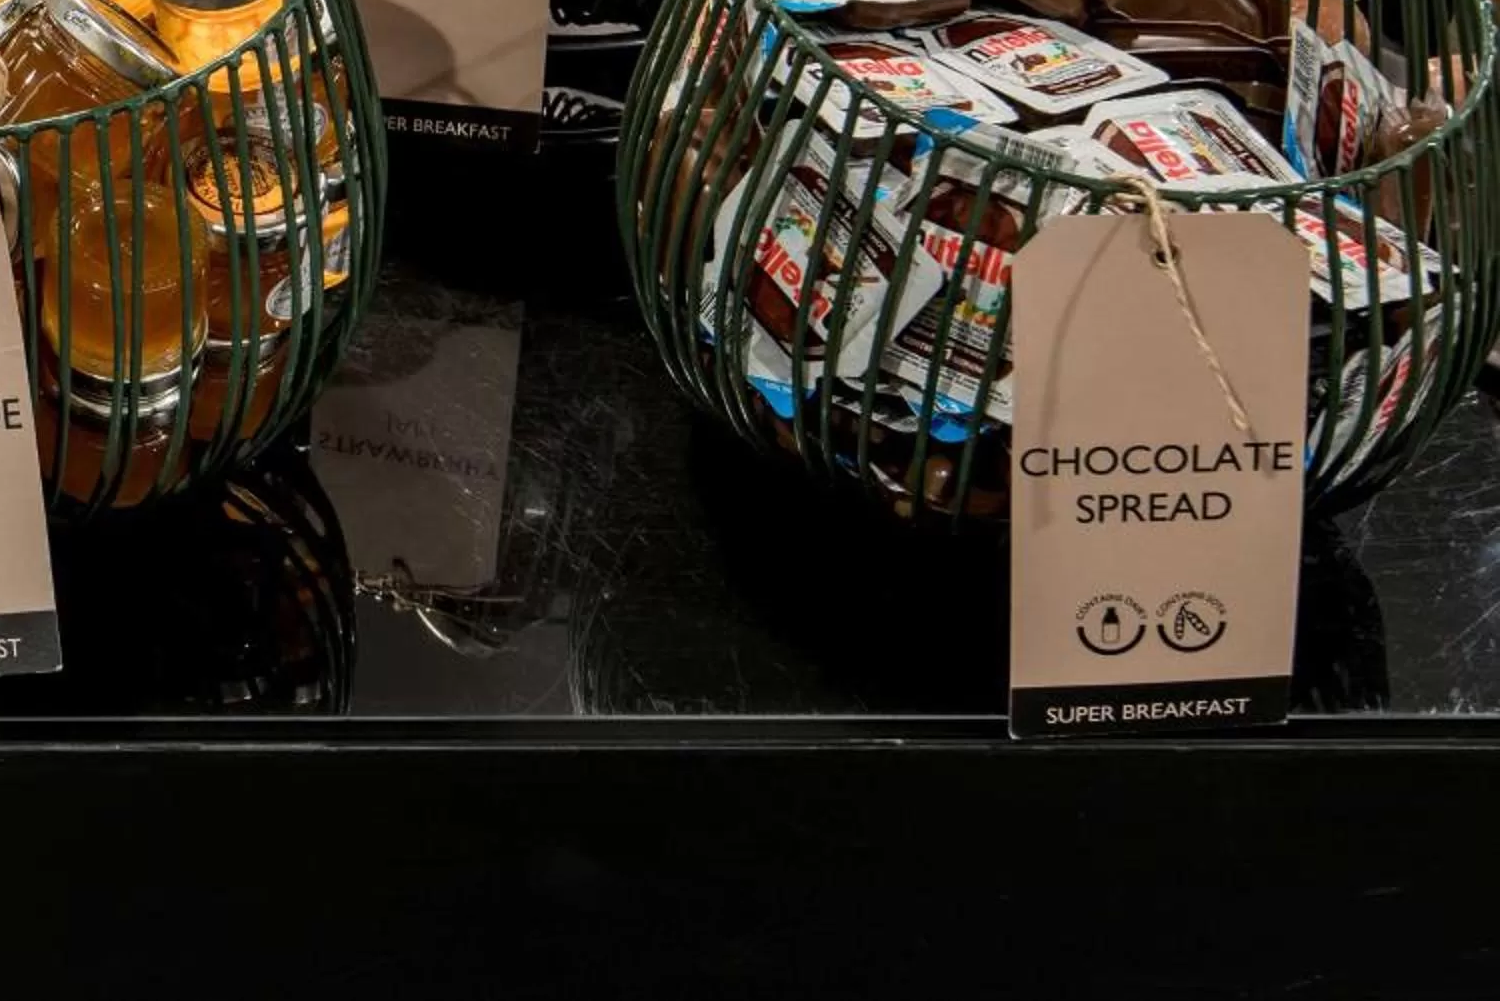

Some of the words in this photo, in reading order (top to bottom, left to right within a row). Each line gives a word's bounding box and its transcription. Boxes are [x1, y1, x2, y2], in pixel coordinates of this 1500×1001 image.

[965, 26, 1055, 64] nutella
[413, 118, 512, 141] BREAKFAST
[1126, 120, 1197, 180] tella
[1020, 442, 1293, 477] CHOCOLATE
[1076, 492, 1232, 523] SPREAD
[1046, 705, 1116, 725] SUPER
[1122, 698, 1251, 721] BREAKFAST
